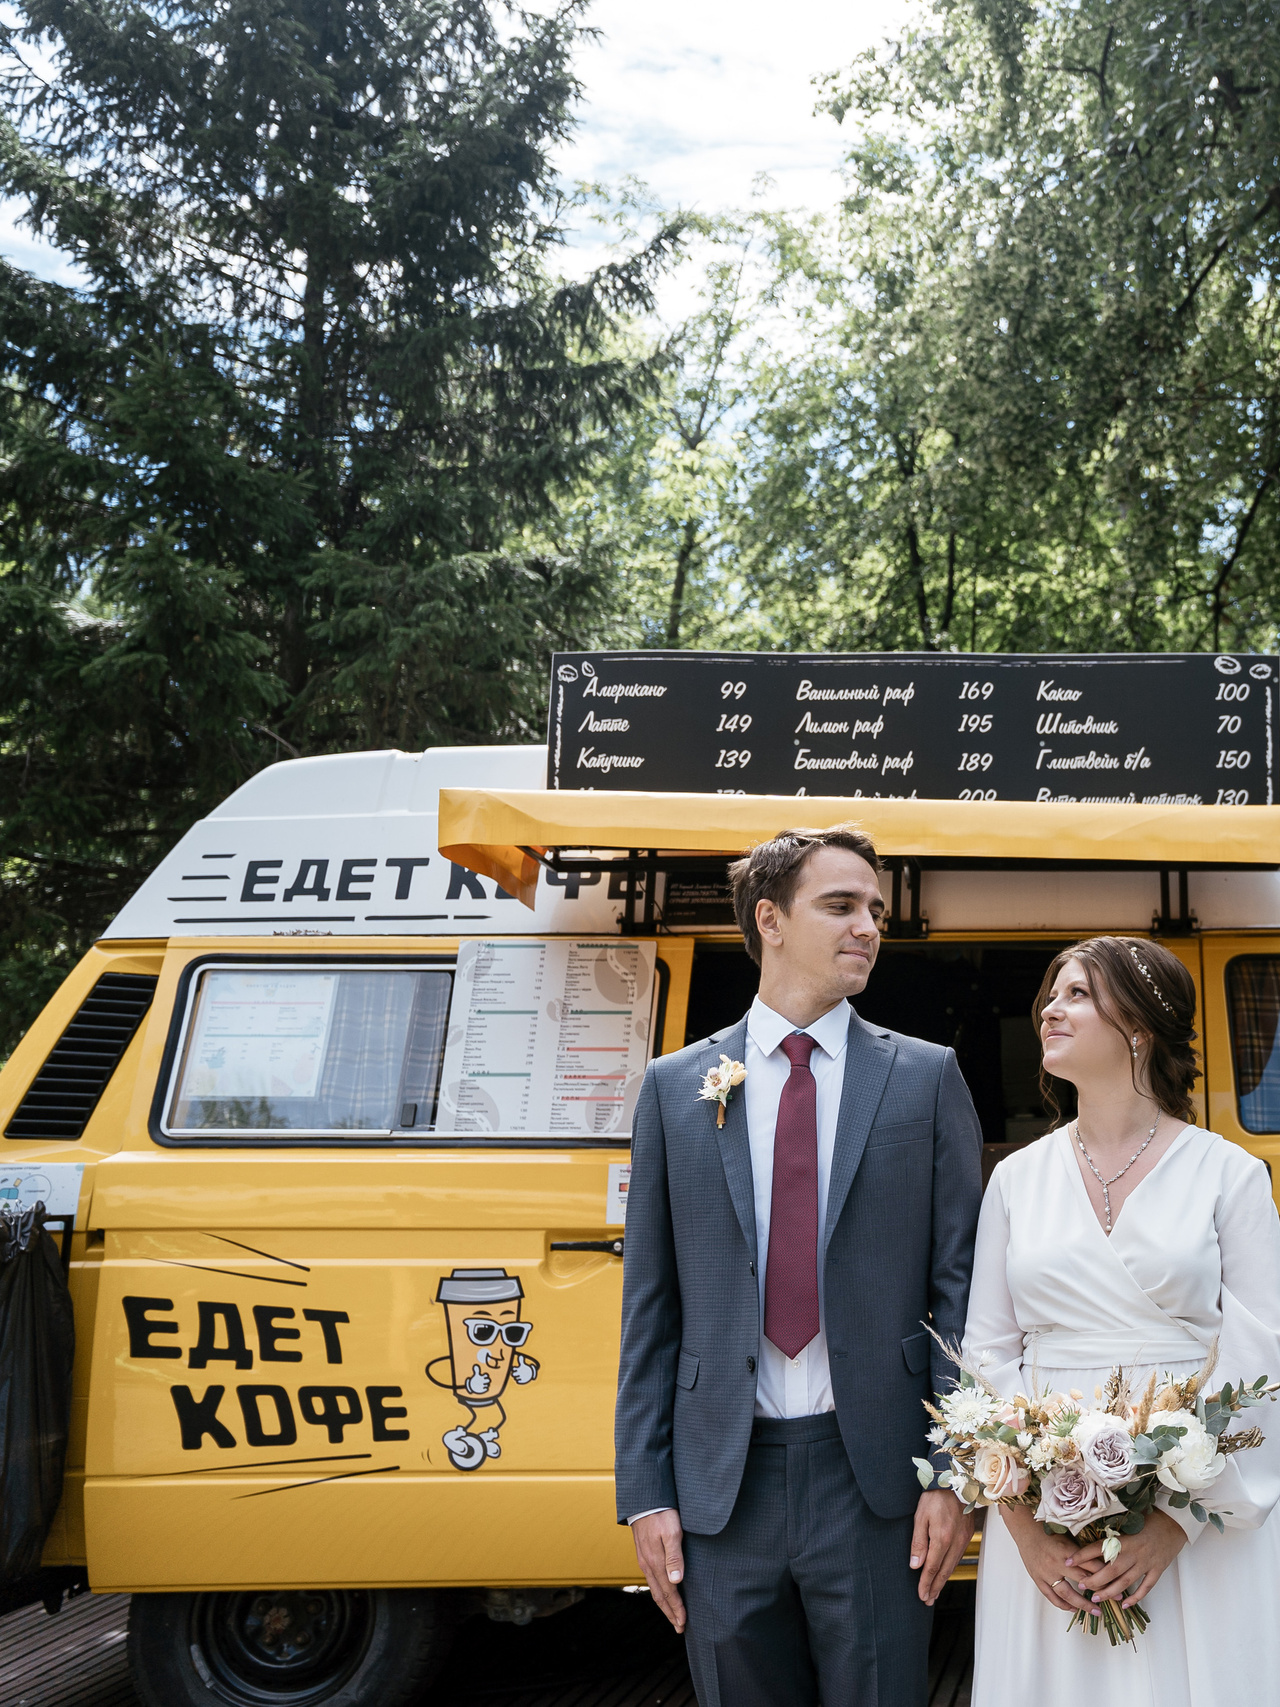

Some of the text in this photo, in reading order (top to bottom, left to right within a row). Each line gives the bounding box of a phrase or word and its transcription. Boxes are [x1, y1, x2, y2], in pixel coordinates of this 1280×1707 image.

[583, 677, 746, 703] Американо 99
[796, 680, 993, 706] Ванильный раф 169
[1037, 680, 1249, 701] Какао 100
[578, 711, 752, 732] Латте 149
[795, 712, 993, 739] Лимон раф 195
[1036, 713, 1241, 734] Шиповник 70
[577, 747, 751, 773] Капучино 139
[794, 749, 993, 775] Банановый раф 189
[1036, 747, 1250, 770] Глинтвейн б/а 150
[1215, 789, 1249, 805] 130
[241, 858, 429, 901] ЕДЕТ
[446, 857, 645, 900] КФЕ
[122, 1296, 349, 1370] ЕДЕТ
[170, 1385, 409, 1450] КОФЕ
